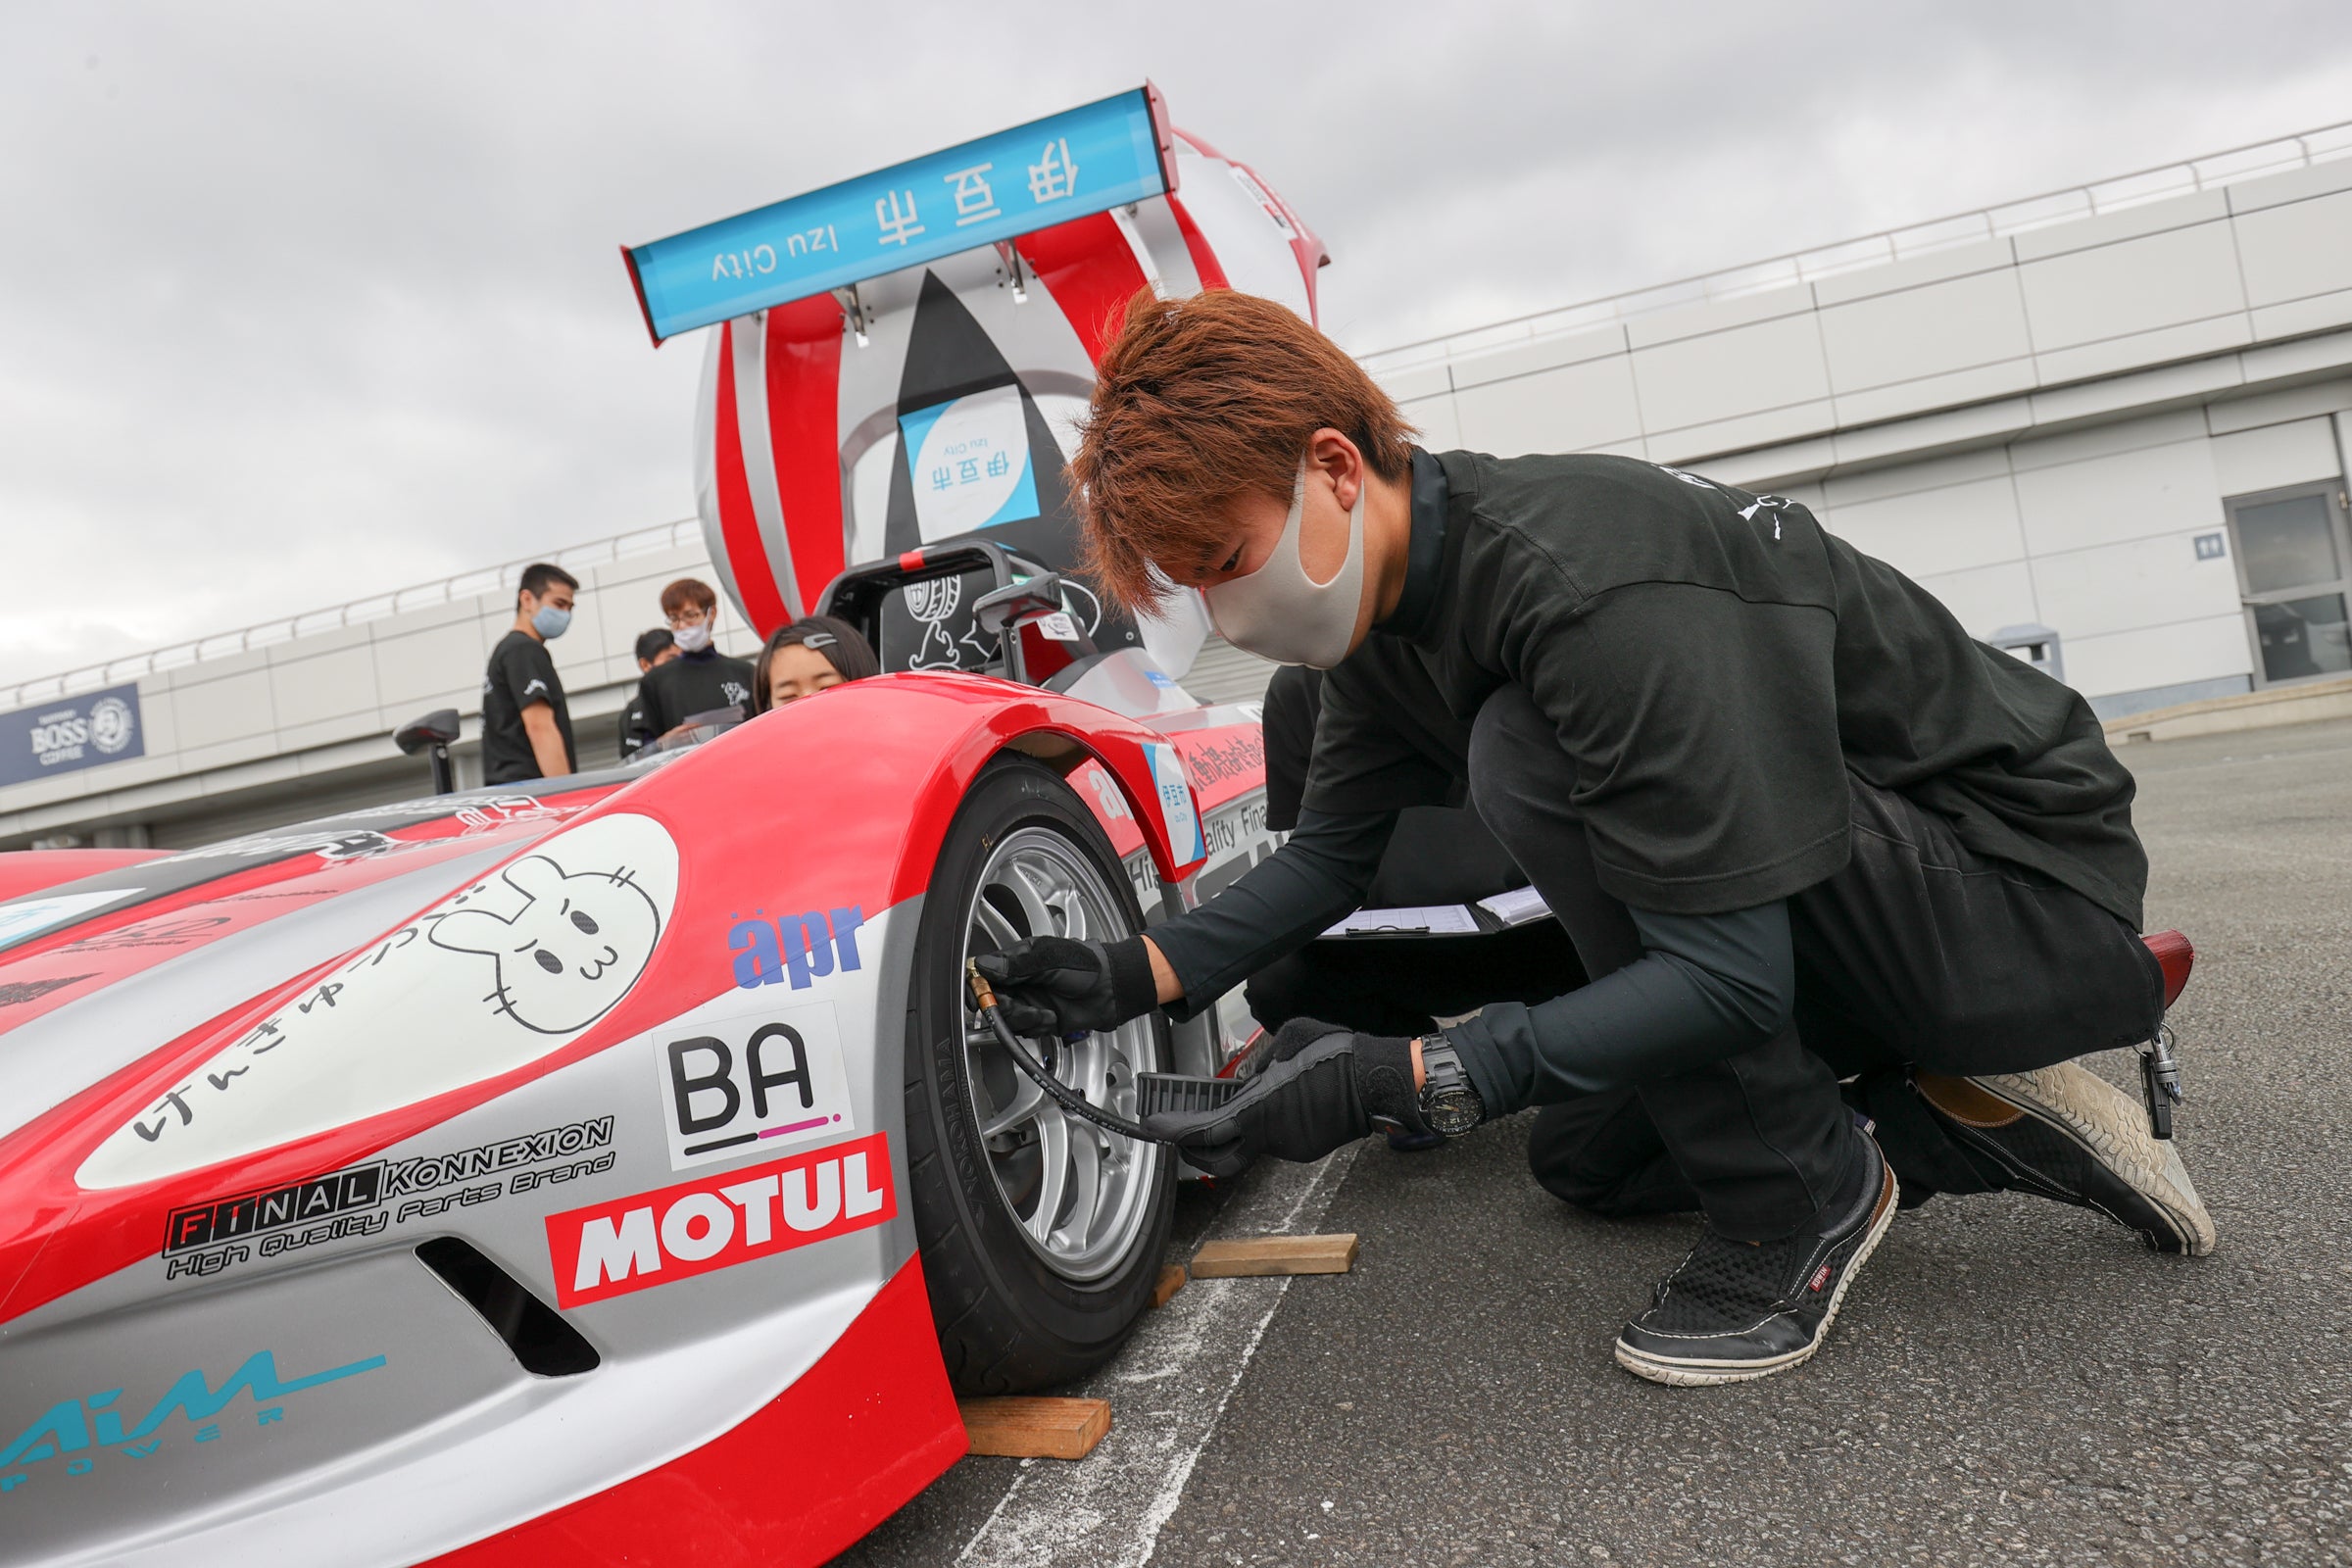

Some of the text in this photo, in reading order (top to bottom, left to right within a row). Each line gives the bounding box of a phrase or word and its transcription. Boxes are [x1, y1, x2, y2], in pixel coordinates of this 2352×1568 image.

[874, 137, 1080, 247] 伊豆市
[711, 221, 839, 281] Izu City
[931, 449, 1010, 492] 伊豆市
[943, 437, 988, 458] Izu City
[30, 717, 88, 754] BOSS
[1162, 784, 1187, 807] 伊豆市
[666, 1022, 814, 1137] BA
[937, 1038, 978, 1196] YOKOHAMA
[167, 1151, 616, 1281] High Quality Parts Brand
[573, 1151, 885, 1293] MOTUL
[1811, 1265, 1829, 1289] EDWIN
[0, 1406, 284, 1493] POWER
